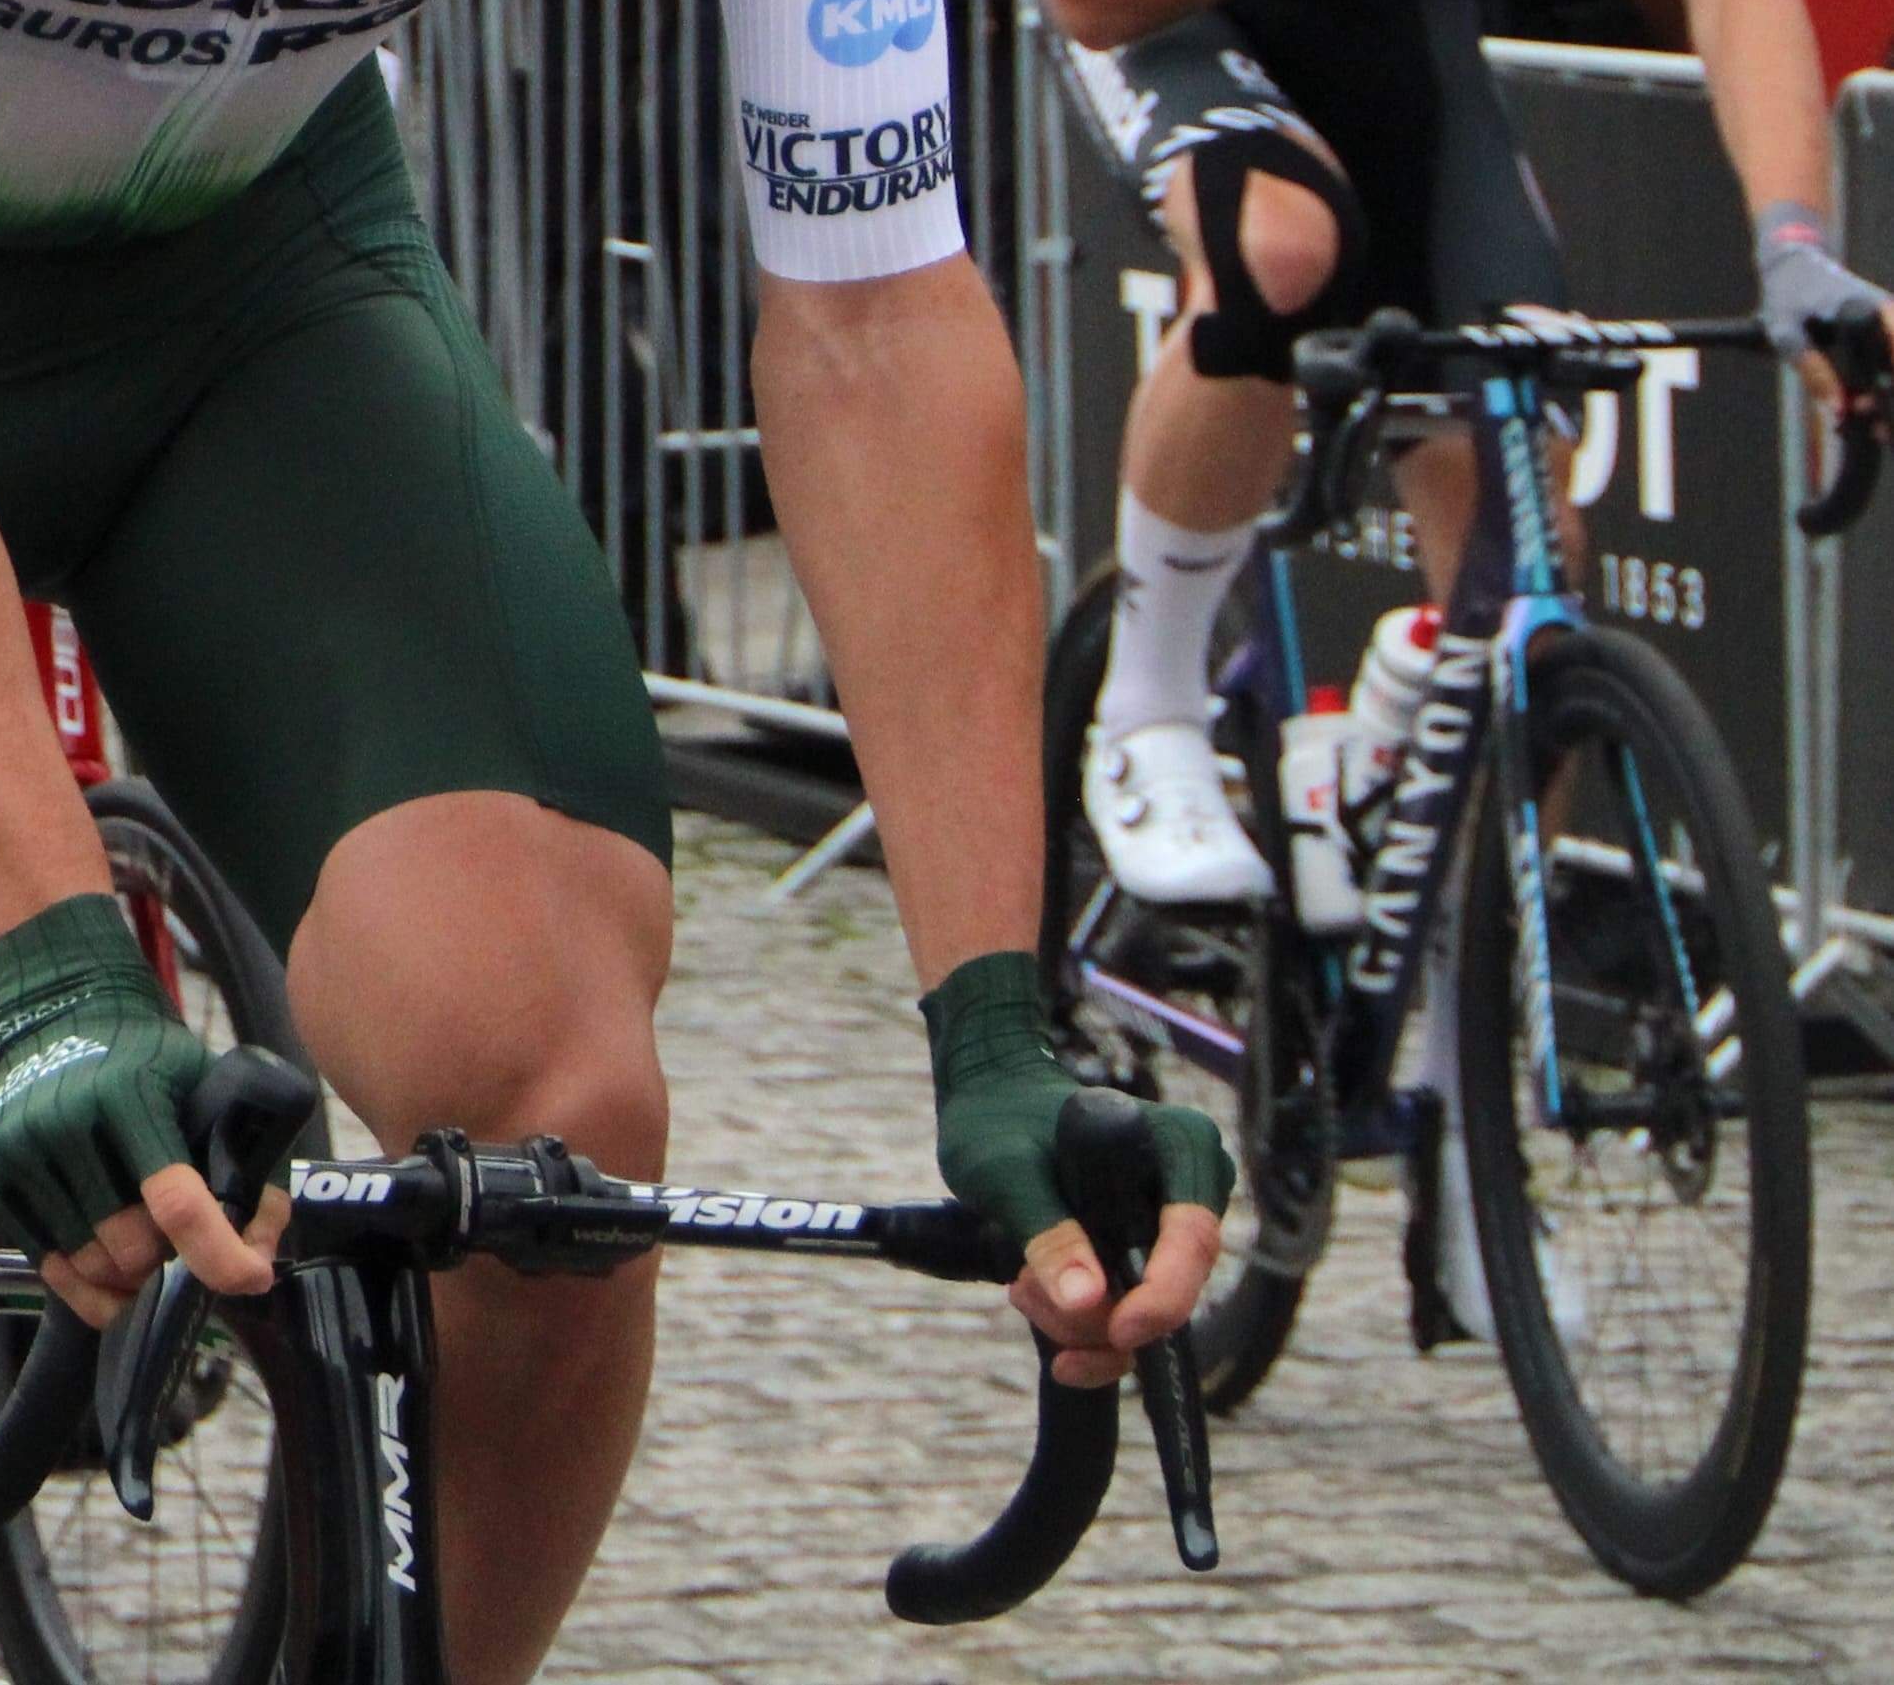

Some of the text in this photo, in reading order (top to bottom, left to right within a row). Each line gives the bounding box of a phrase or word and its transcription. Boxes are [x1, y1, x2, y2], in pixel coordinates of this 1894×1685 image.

[1600, 553, 1706, 630] 1853
[1348, 633, 1491, 993] CANYON
[376, 1372, 417, 1593] MMR
